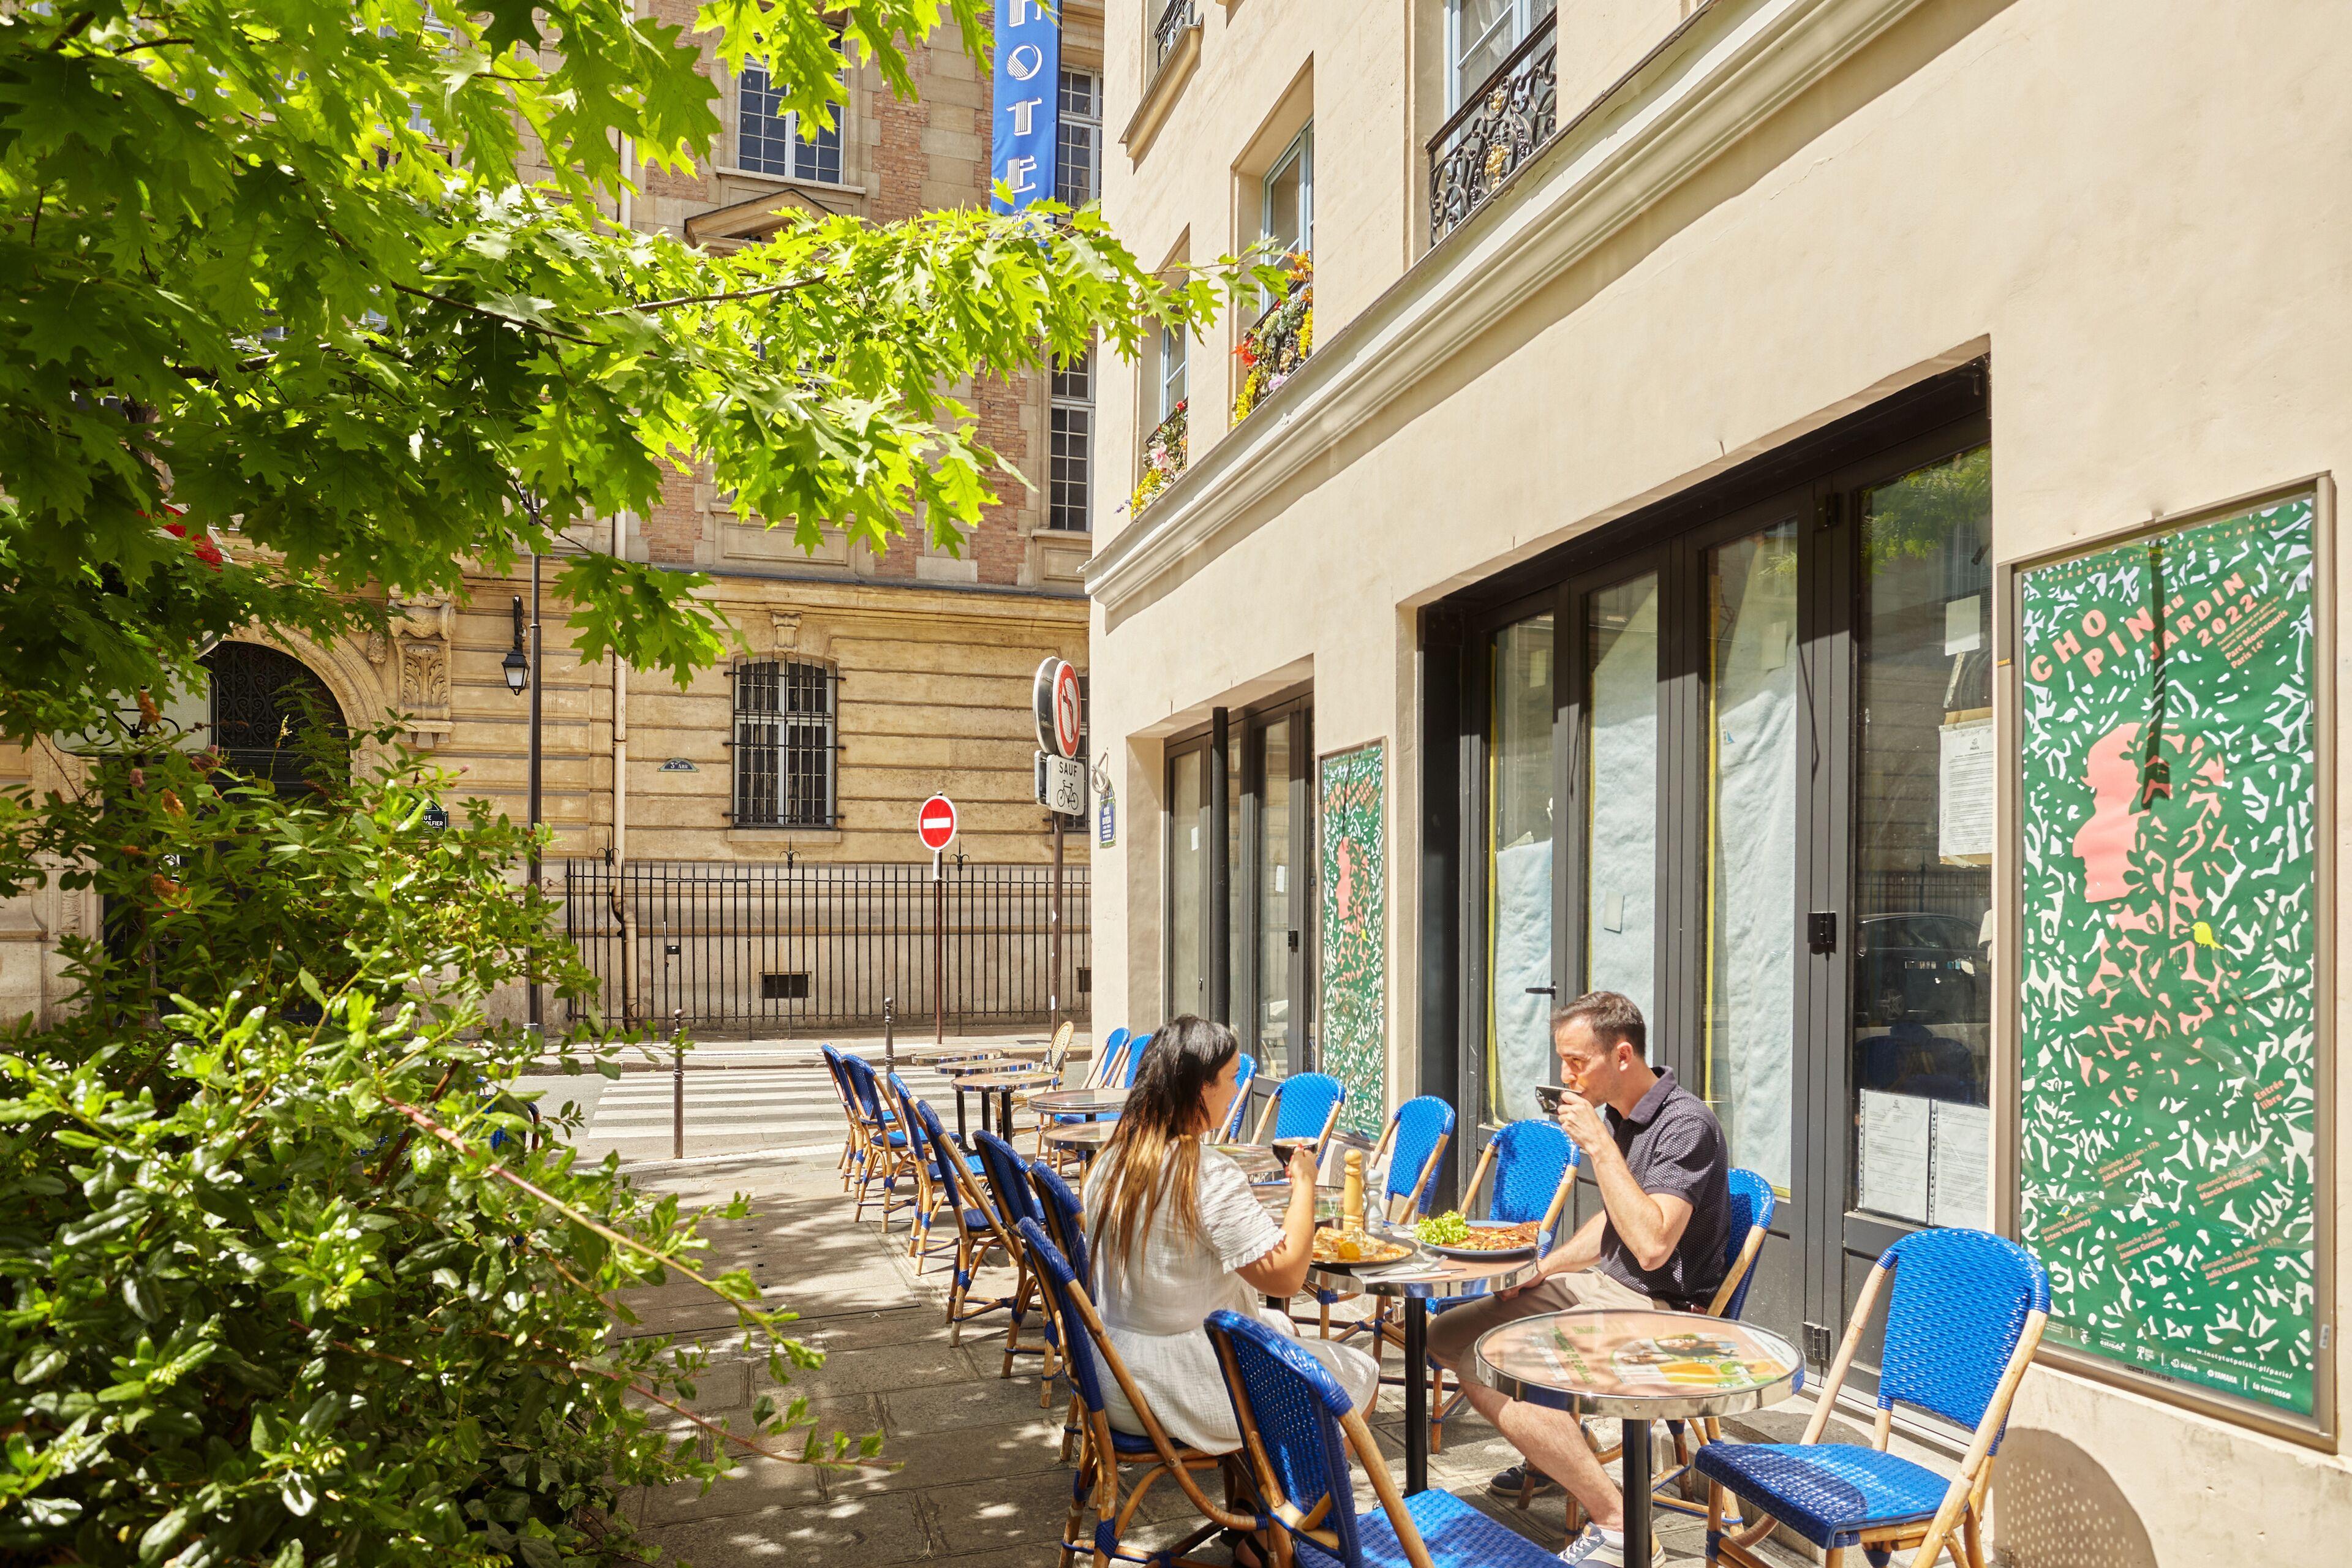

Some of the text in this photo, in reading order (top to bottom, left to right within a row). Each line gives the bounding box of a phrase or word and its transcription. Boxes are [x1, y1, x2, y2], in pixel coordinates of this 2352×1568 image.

[1006, 0, 1042, 236] HOTE
[2049, 559, 2120, 582] VARSOVIE
[2225, 519, 2277, 538] PARIS
[2149, 572, 2245, 661] JARDIN
[2162, 594, 2185, 618] au
[2197, 594, 2258, 648] 2022
[2225, 609, 2288, 660] Parc Montsouris
[2231, 651, 2252, 669] Paris
[1059, 761, 1077, 777] SAUF
[2254, 1080, 2285, 1101] Entrée
[2260, 1094, 2282, 1110] libre
[2098, 1158, 2124, 1174] dimanche
[2147, 1141, 2160, 1150] 17h
[2102, 1169, 2119, 1182] Jakub
[2196, 1175, 2228, 1191] dimanche
[2199, 1169, 2264, 1200] Marcin Wieczorek
[2043, 1217, 2092, 1243] Artem Yasynskyy
[2116, 1237, 2143, 1251] dimanche
[2168, 1219, 2181, 1229] 17h
[2200, 1256, 2233, 1272] dimanche
[2267, 1237, 2283, 1246] 17h
[2205, 1268, 2223, 1280] Julia
[2179, 1362, 2198, 1373] PARIS
[2214, 1370, 2238, 1385] YAMAHA
[2252, 1381, 2292, 1400] la terrasse
